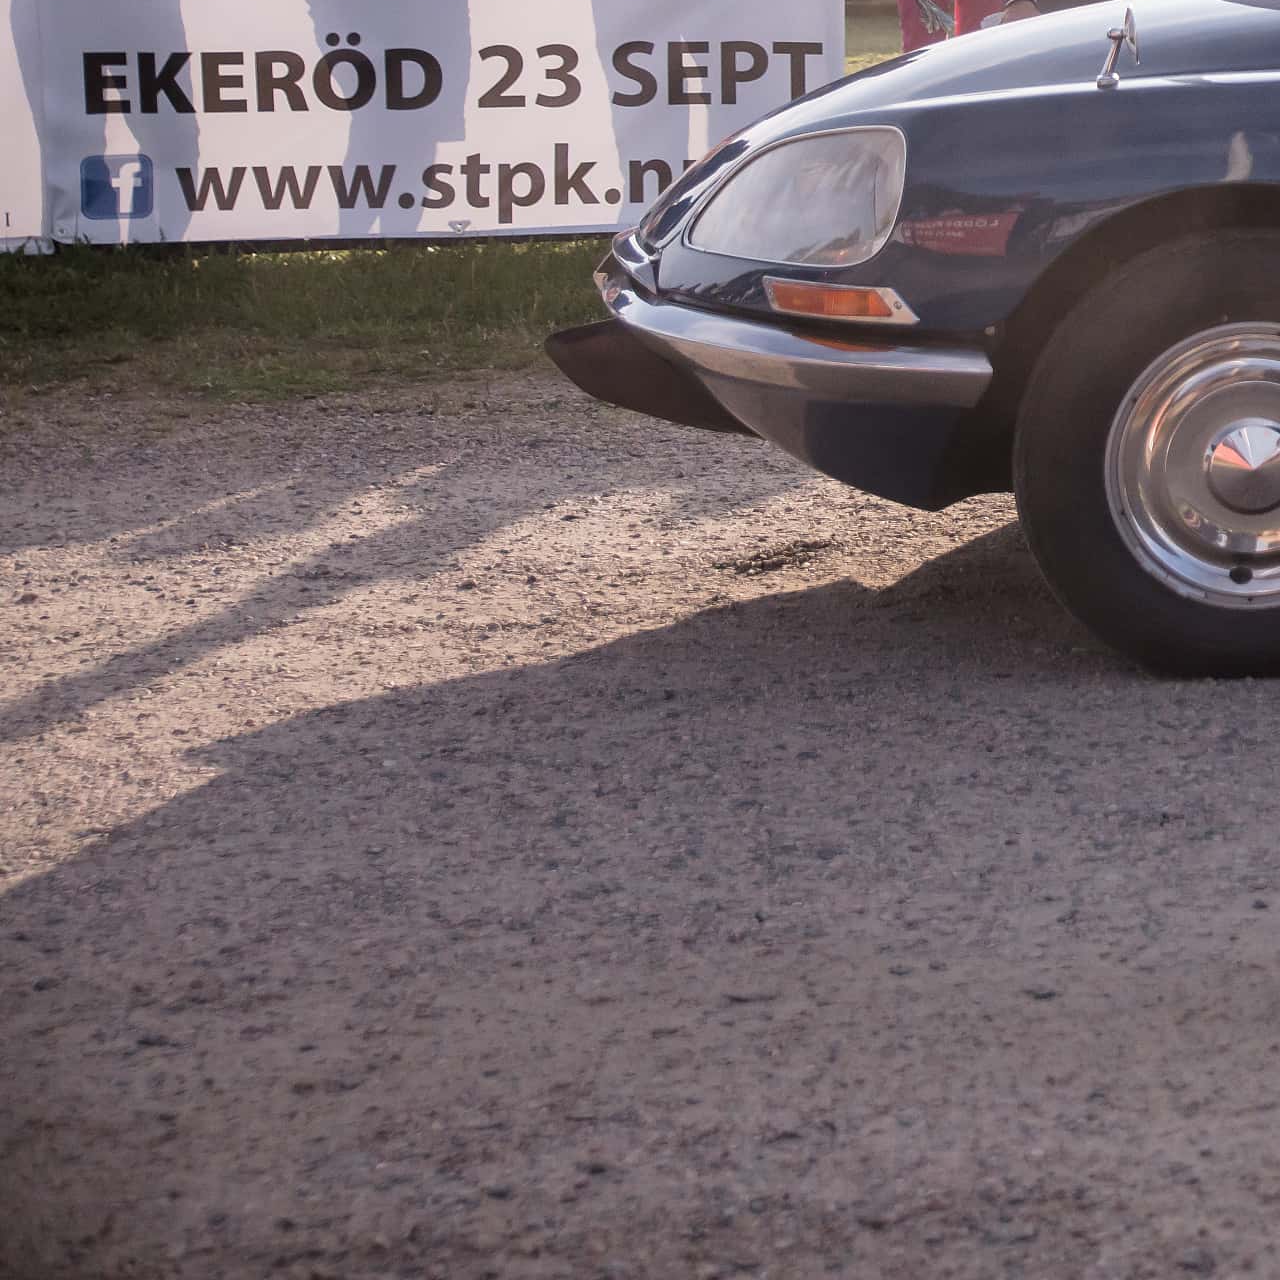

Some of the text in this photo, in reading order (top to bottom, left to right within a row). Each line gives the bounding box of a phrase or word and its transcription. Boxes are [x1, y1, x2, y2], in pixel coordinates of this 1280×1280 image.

[82, 32, 824, 115] EKERÖD 23 SEPT
[174, 143, 698, 223] www.stpk.n
